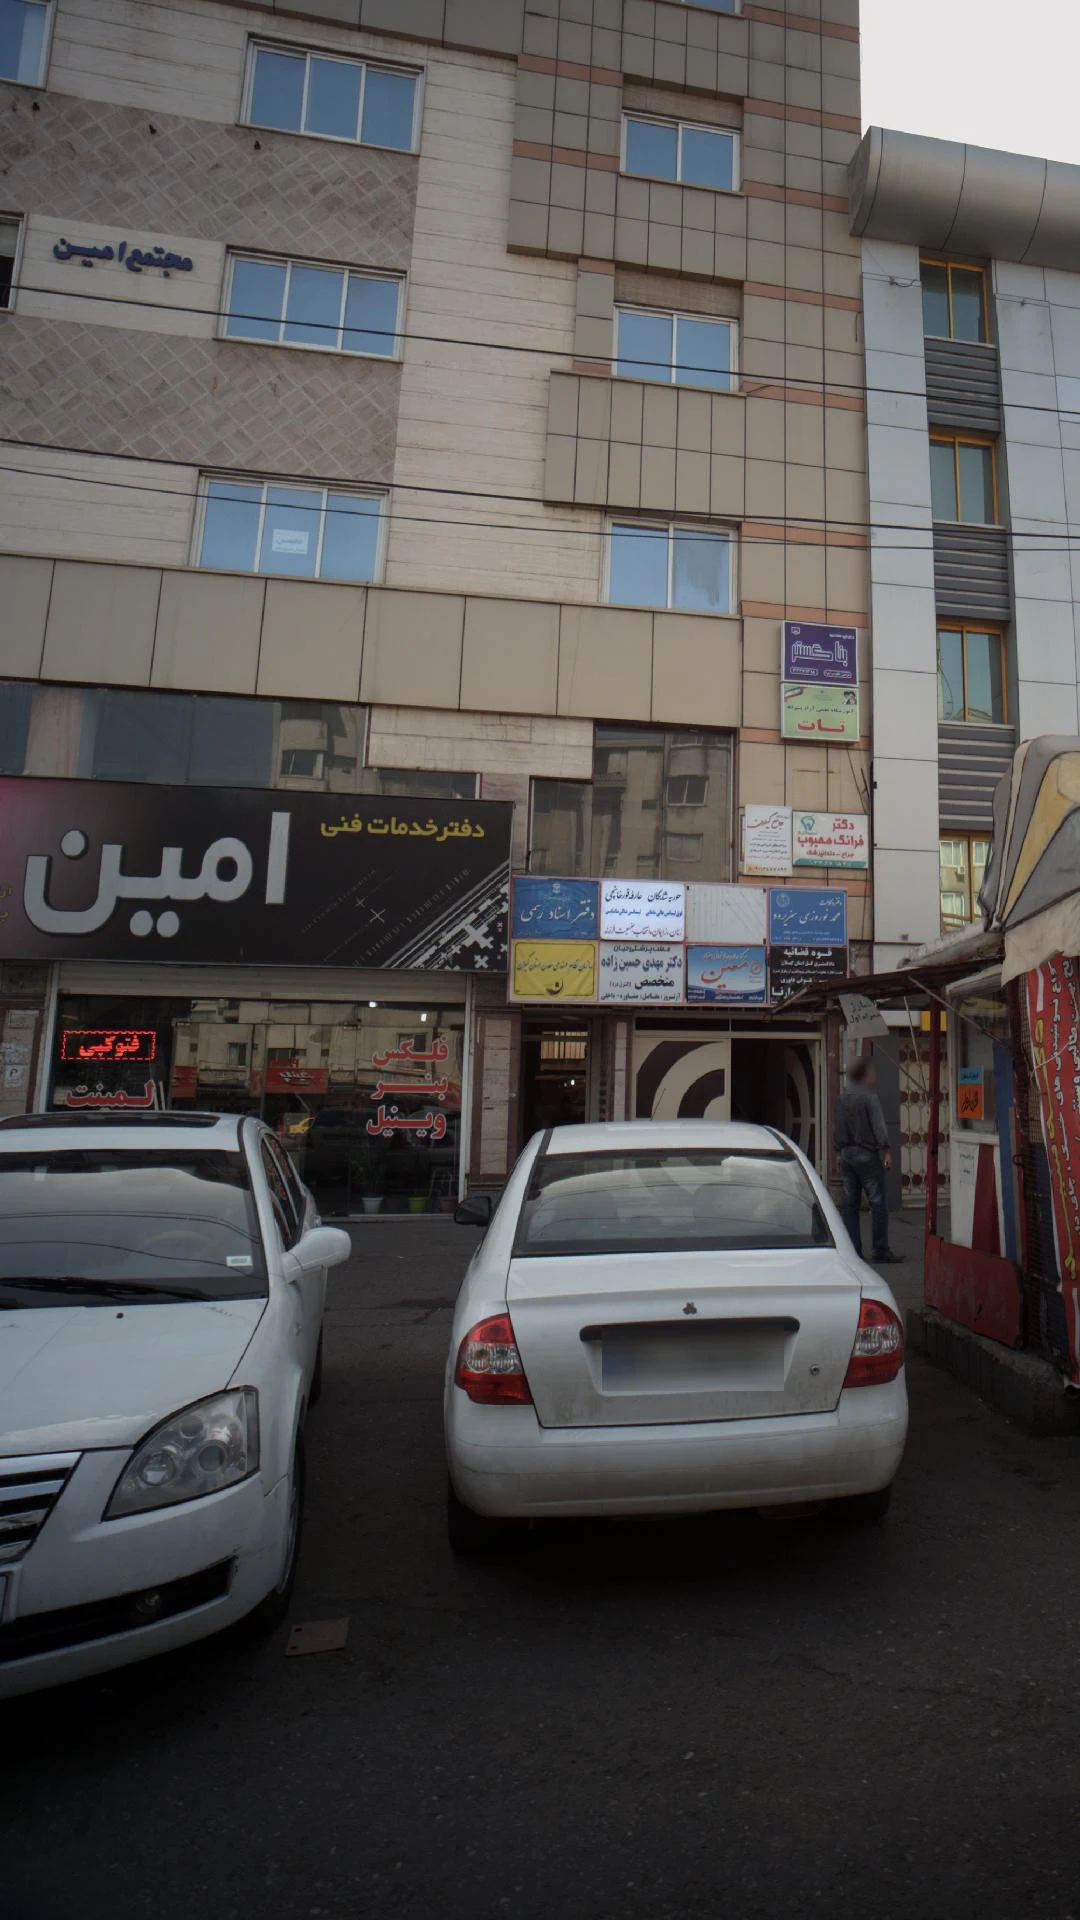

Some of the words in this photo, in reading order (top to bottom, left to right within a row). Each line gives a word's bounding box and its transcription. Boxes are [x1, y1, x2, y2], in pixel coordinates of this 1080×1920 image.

[53, 238, 127, 267] امین
[126, 246, 193, 278] مجتمع
[320, 812, 362, 837] فنی
[367, 816, 438, 836] خدمات
[436, 817, 485, 842] دفتر
[832, 818, 855, 832] دکتر
[24, 811, 291, 937] امین
[521, 904, 543, 922] رسمی
[548, 906, 570, 920] اسناد
[569, 899, 594, 925] دفتر
[601, 955, 618, 972] زاده
[619, 957, 641, 972] حسین
[642, 958, 664, 972] مهدی
[665, 955, 682, 972] دکتر
[701, 960, 747, 988] معین
[635, 976, 675, 989] متخصص
[79, 1034, 140, 1057] فتوکپی
[372, 1034, 449, 1067] فلکس
[66, 1079, 155, 1111] لمینت
[370, 1073, 448, 1101] بنر
[1053, 1076, 1064, 1106] های
[366, 1105, 447, 1139] وینیل
